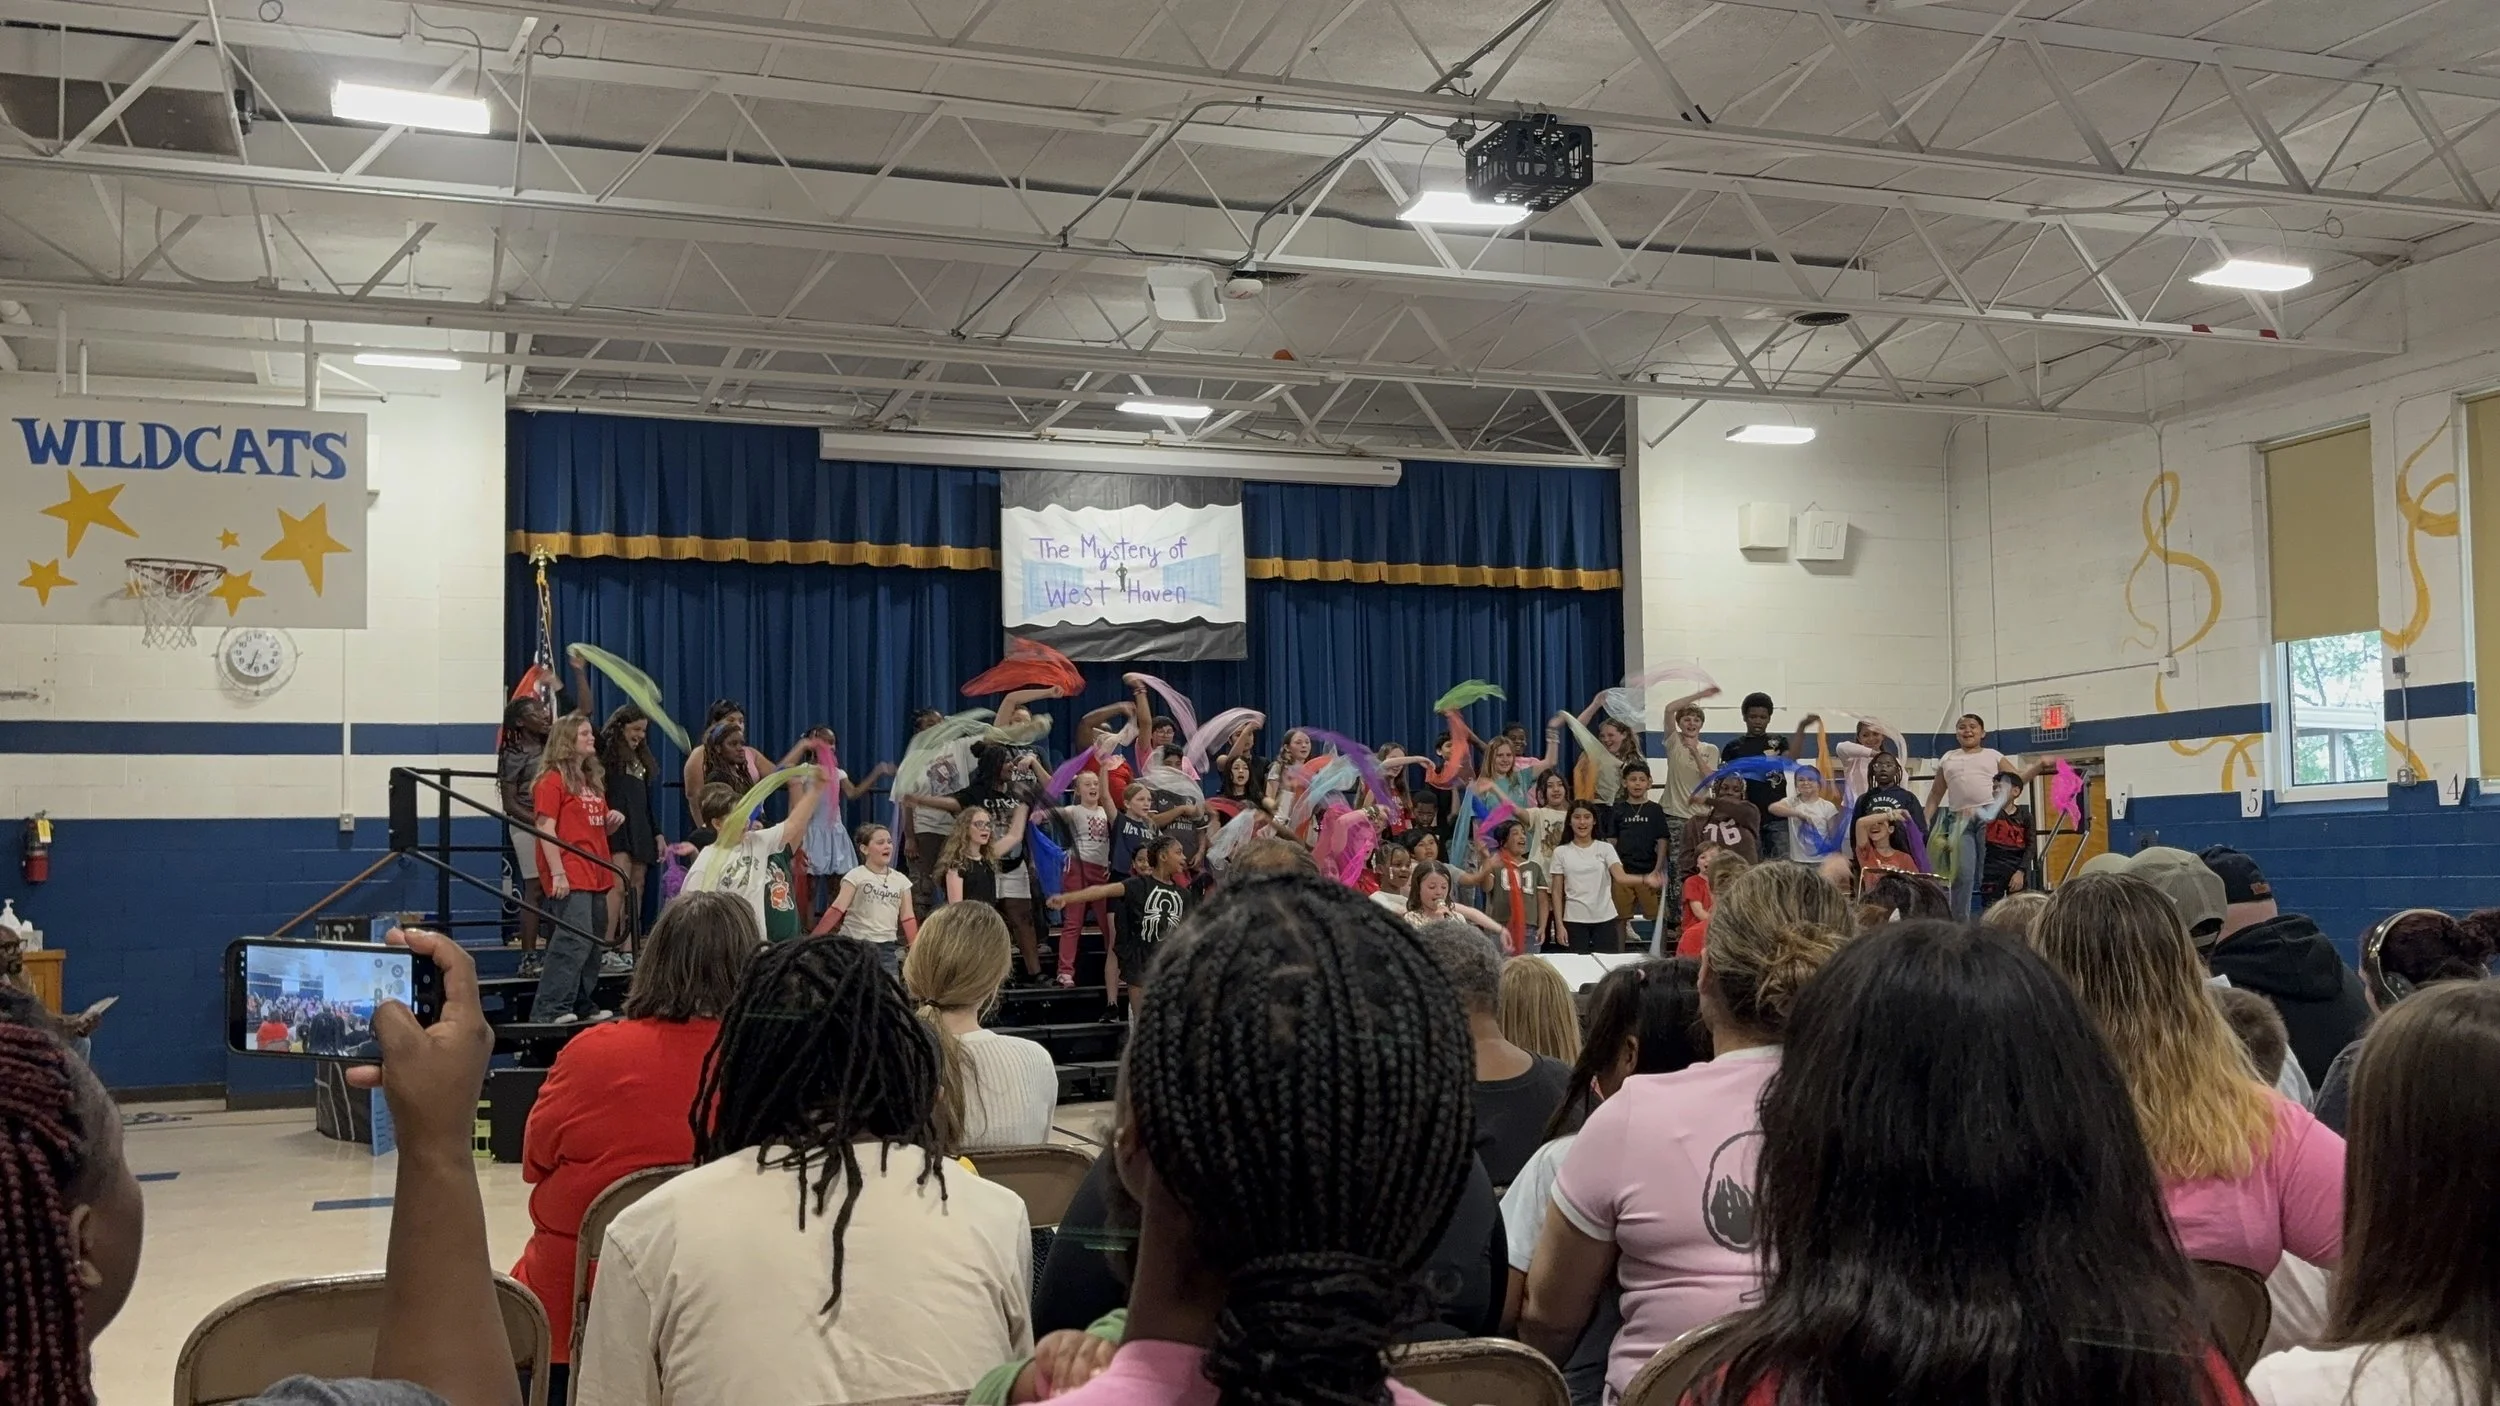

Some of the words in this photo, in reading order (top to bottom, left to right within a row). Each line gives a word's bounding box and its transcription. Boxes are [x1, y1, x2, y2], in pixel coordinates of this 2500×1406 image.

[12, 418, 347, 480] WILDCATS
[1029, 537, 1070, 559] The
[1081, 534, 1161, 570] Mystery
[1168, 536, 1188, 559] of
[1044, 580, 1111, 608] West
[1127, 578, 1187, 605] Haven
[2246, 788, 2259, 814] 5
[2446, 773, 2461, 801] 4
[1702, 819, 1742, 846] 76
